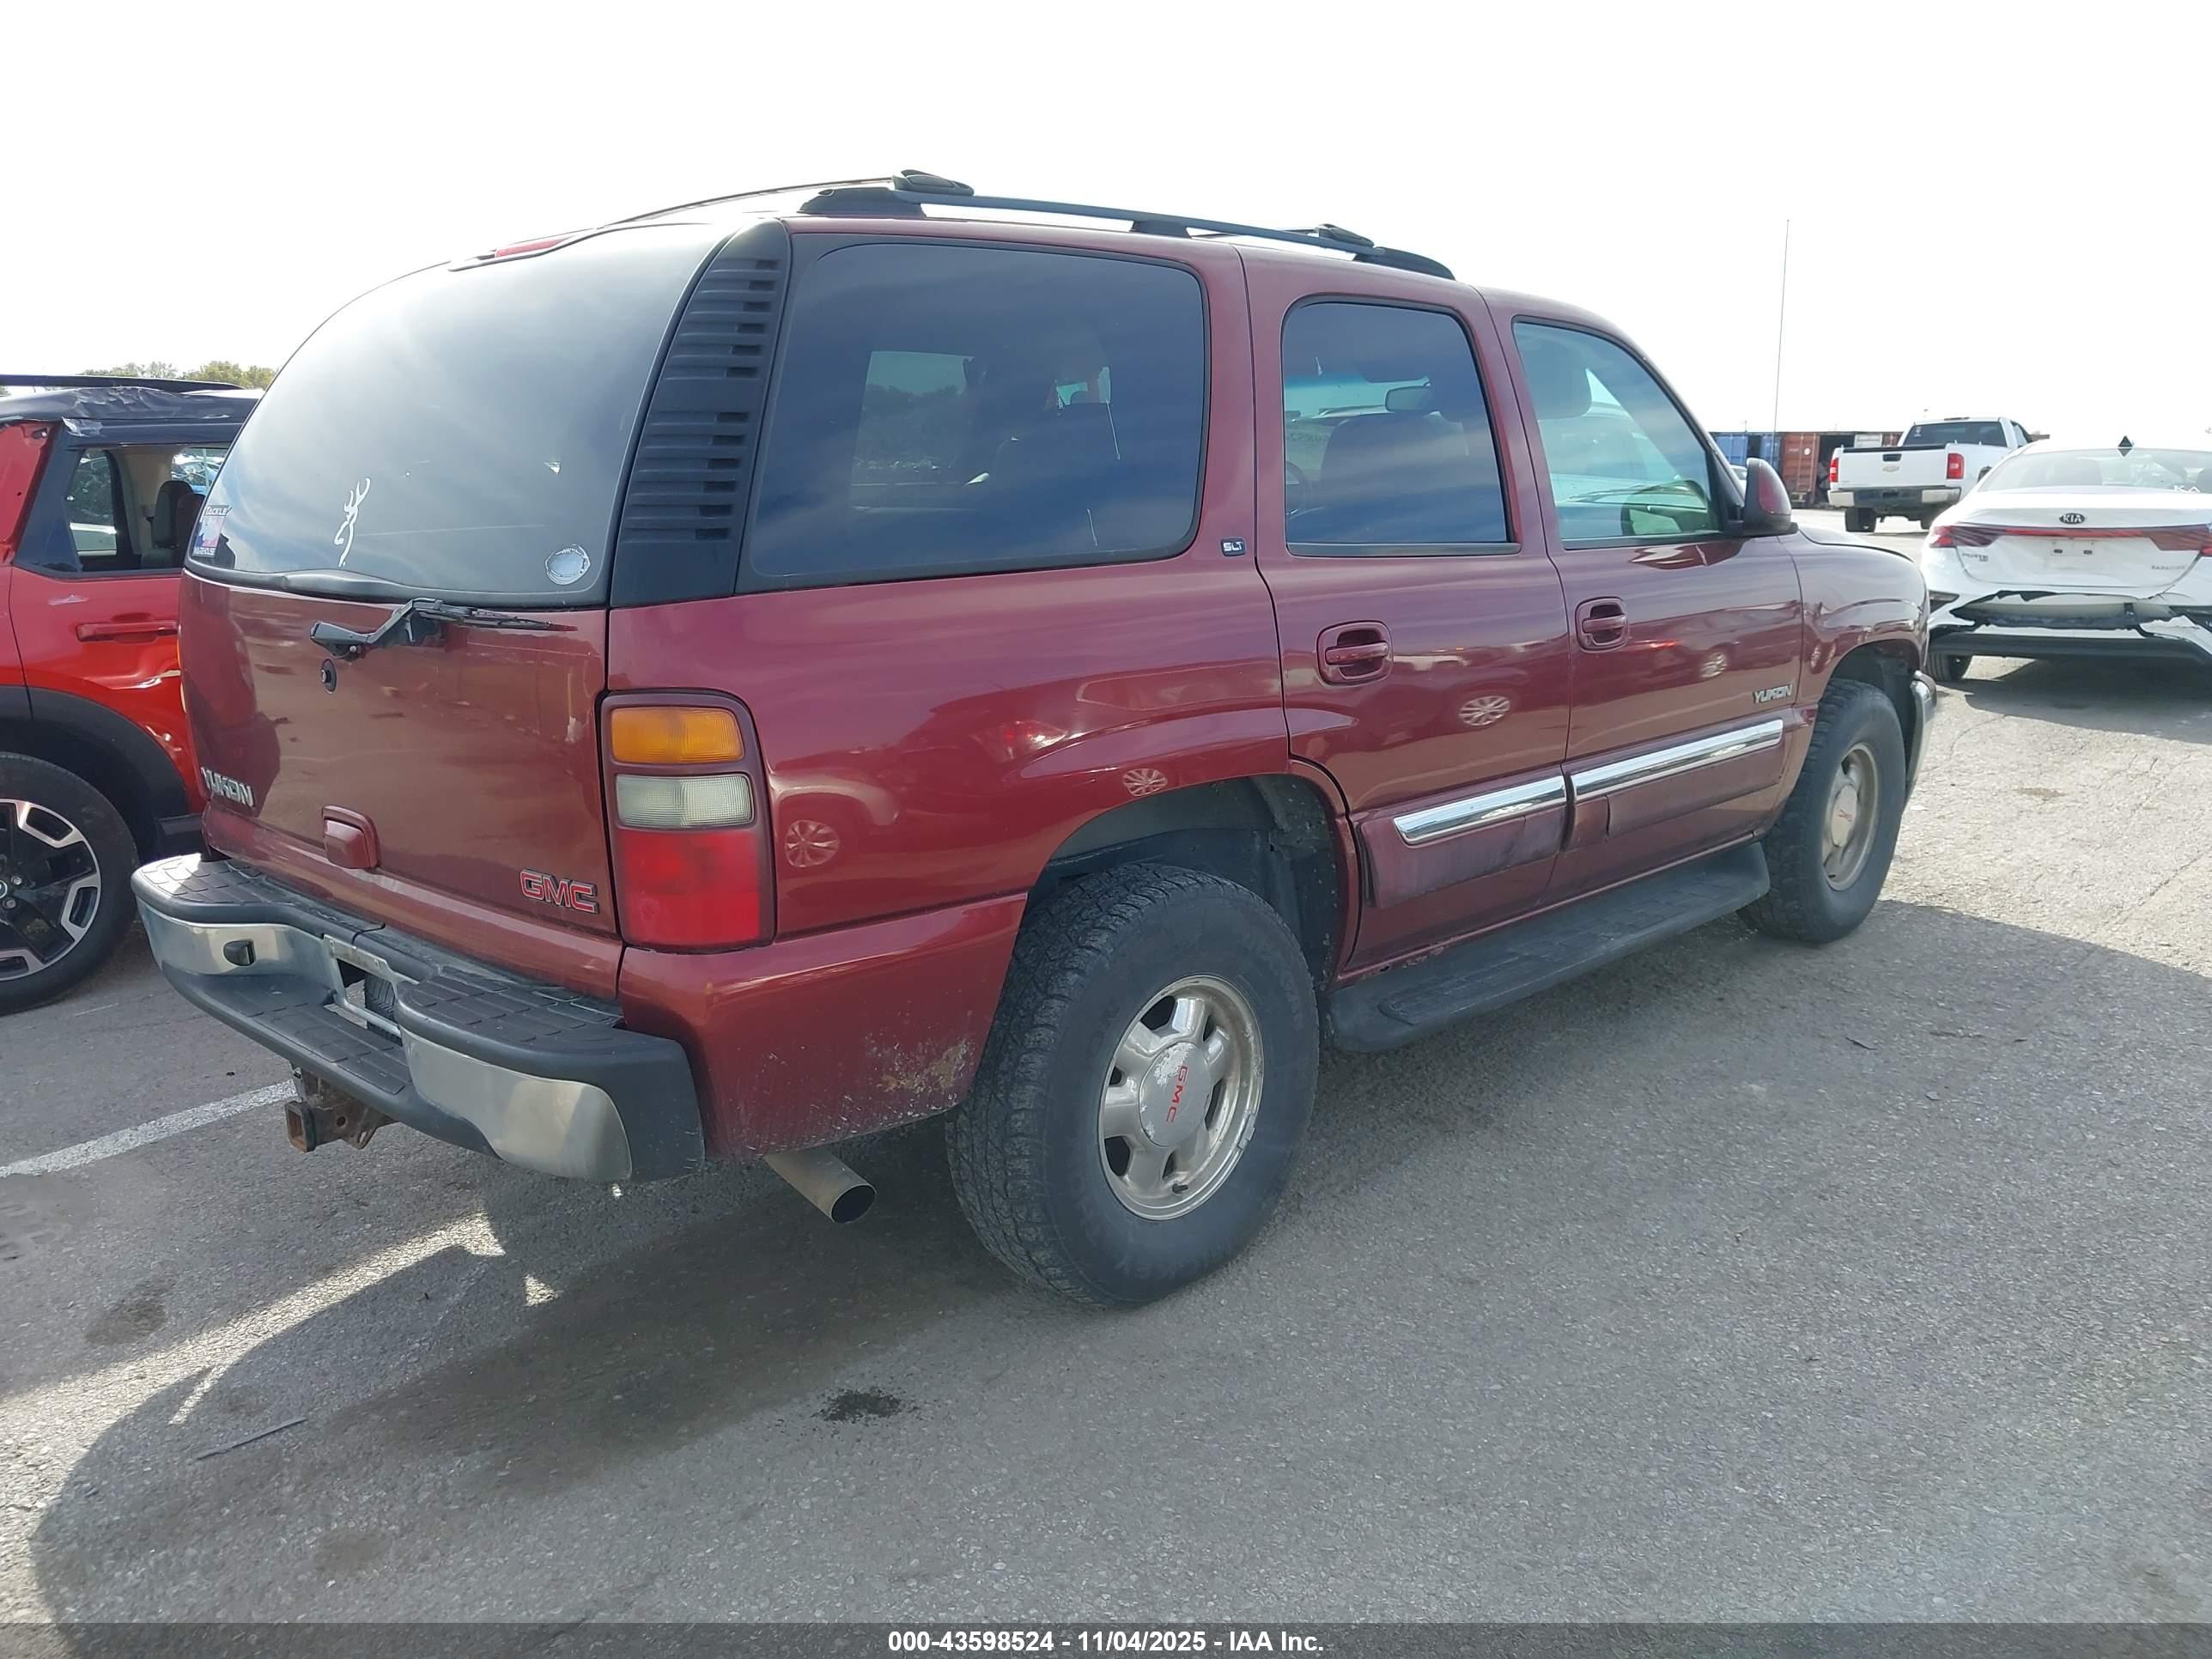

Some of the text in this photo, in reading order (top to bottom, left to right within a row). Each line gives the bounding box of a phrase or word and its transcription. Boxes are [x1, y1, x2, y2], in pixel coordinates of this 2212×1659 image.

[1223, 541, 1243, 552] SLT
[1753, 684, 1793, 703] YUKON
[200, 765, 255, 807] YUKON
[520, 869, 599, 914] GMC
[1165, 1065, 1188, 1123] GMC
